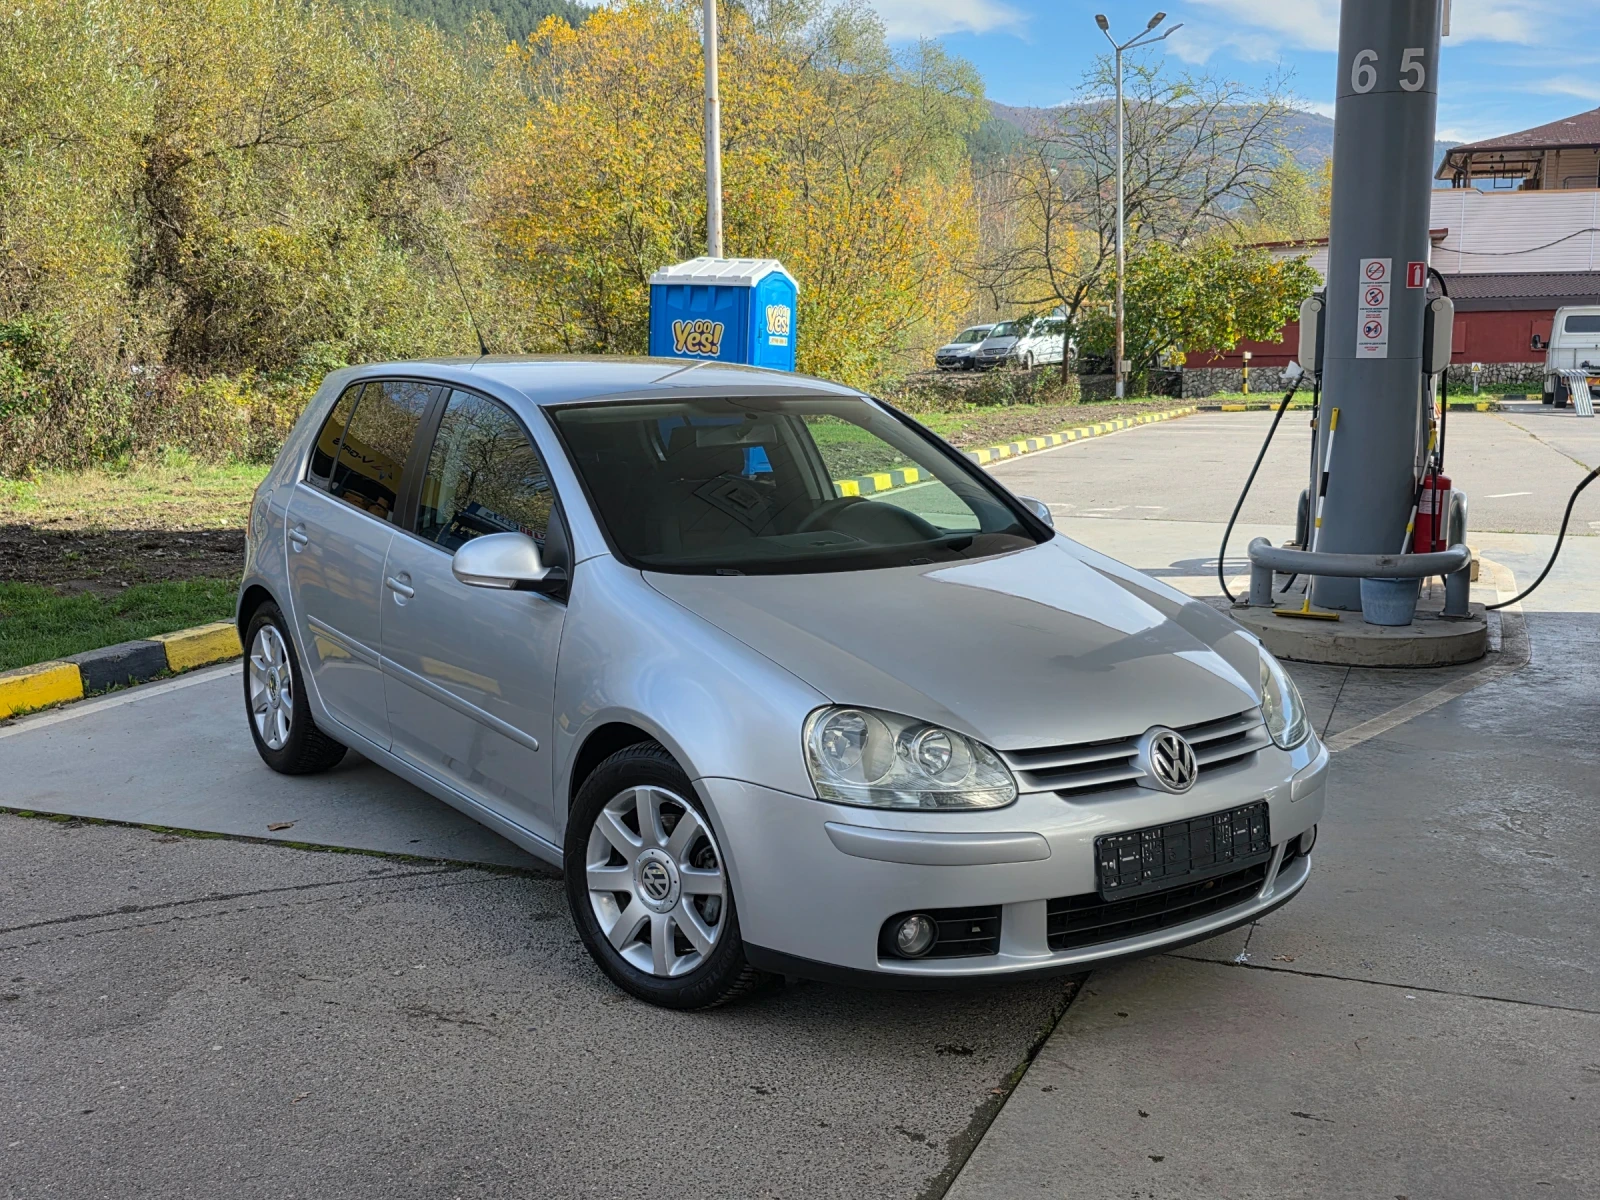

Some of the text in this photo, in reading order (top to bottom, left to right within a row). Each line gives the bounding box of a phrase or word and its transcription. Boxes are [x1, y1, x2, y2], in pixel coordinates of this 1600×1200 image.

[1351, 47, 1425, 94] 6 5
[673, 320, 723, 355] Yes!
